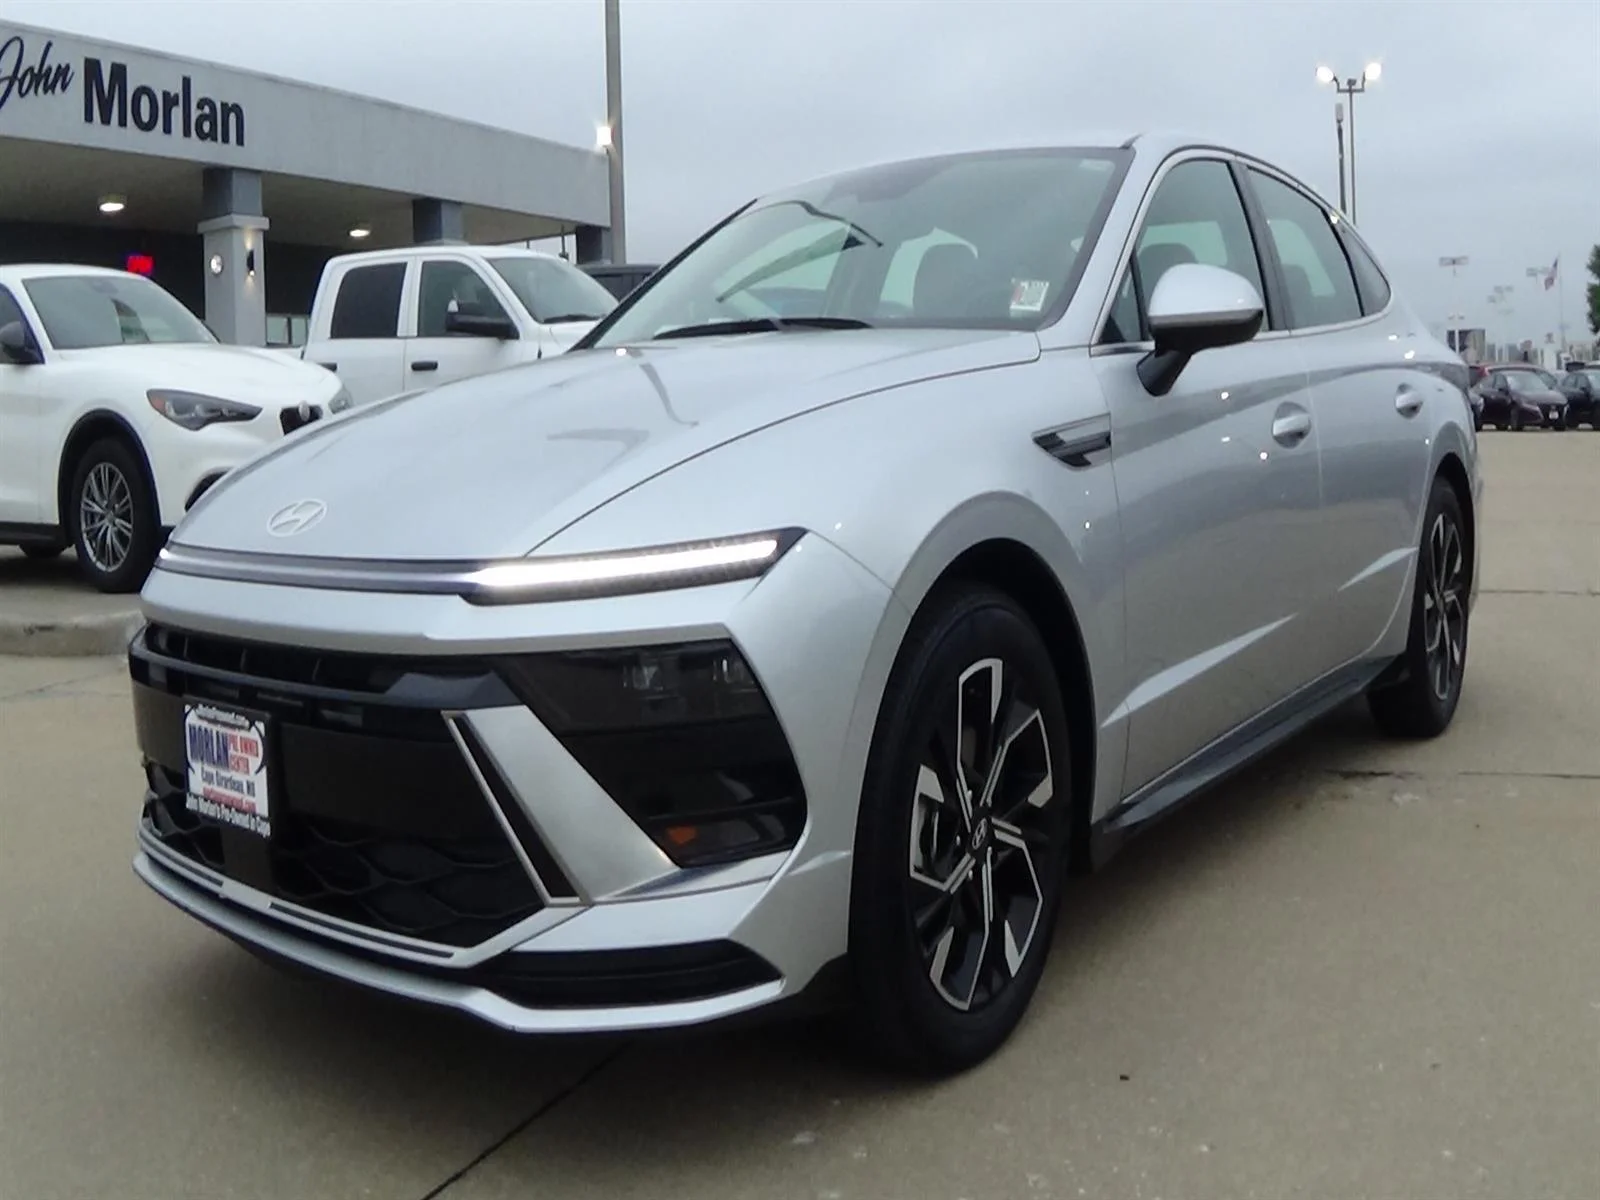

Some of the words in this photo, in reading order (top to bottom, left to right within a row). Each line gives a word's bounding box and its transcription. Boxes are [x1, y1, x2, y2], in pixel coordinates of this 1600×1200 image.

[0, 36, 74, 110] John
[84, 57, 244, 146] Morlan
[188, 723, 229, 771] MORLAN
